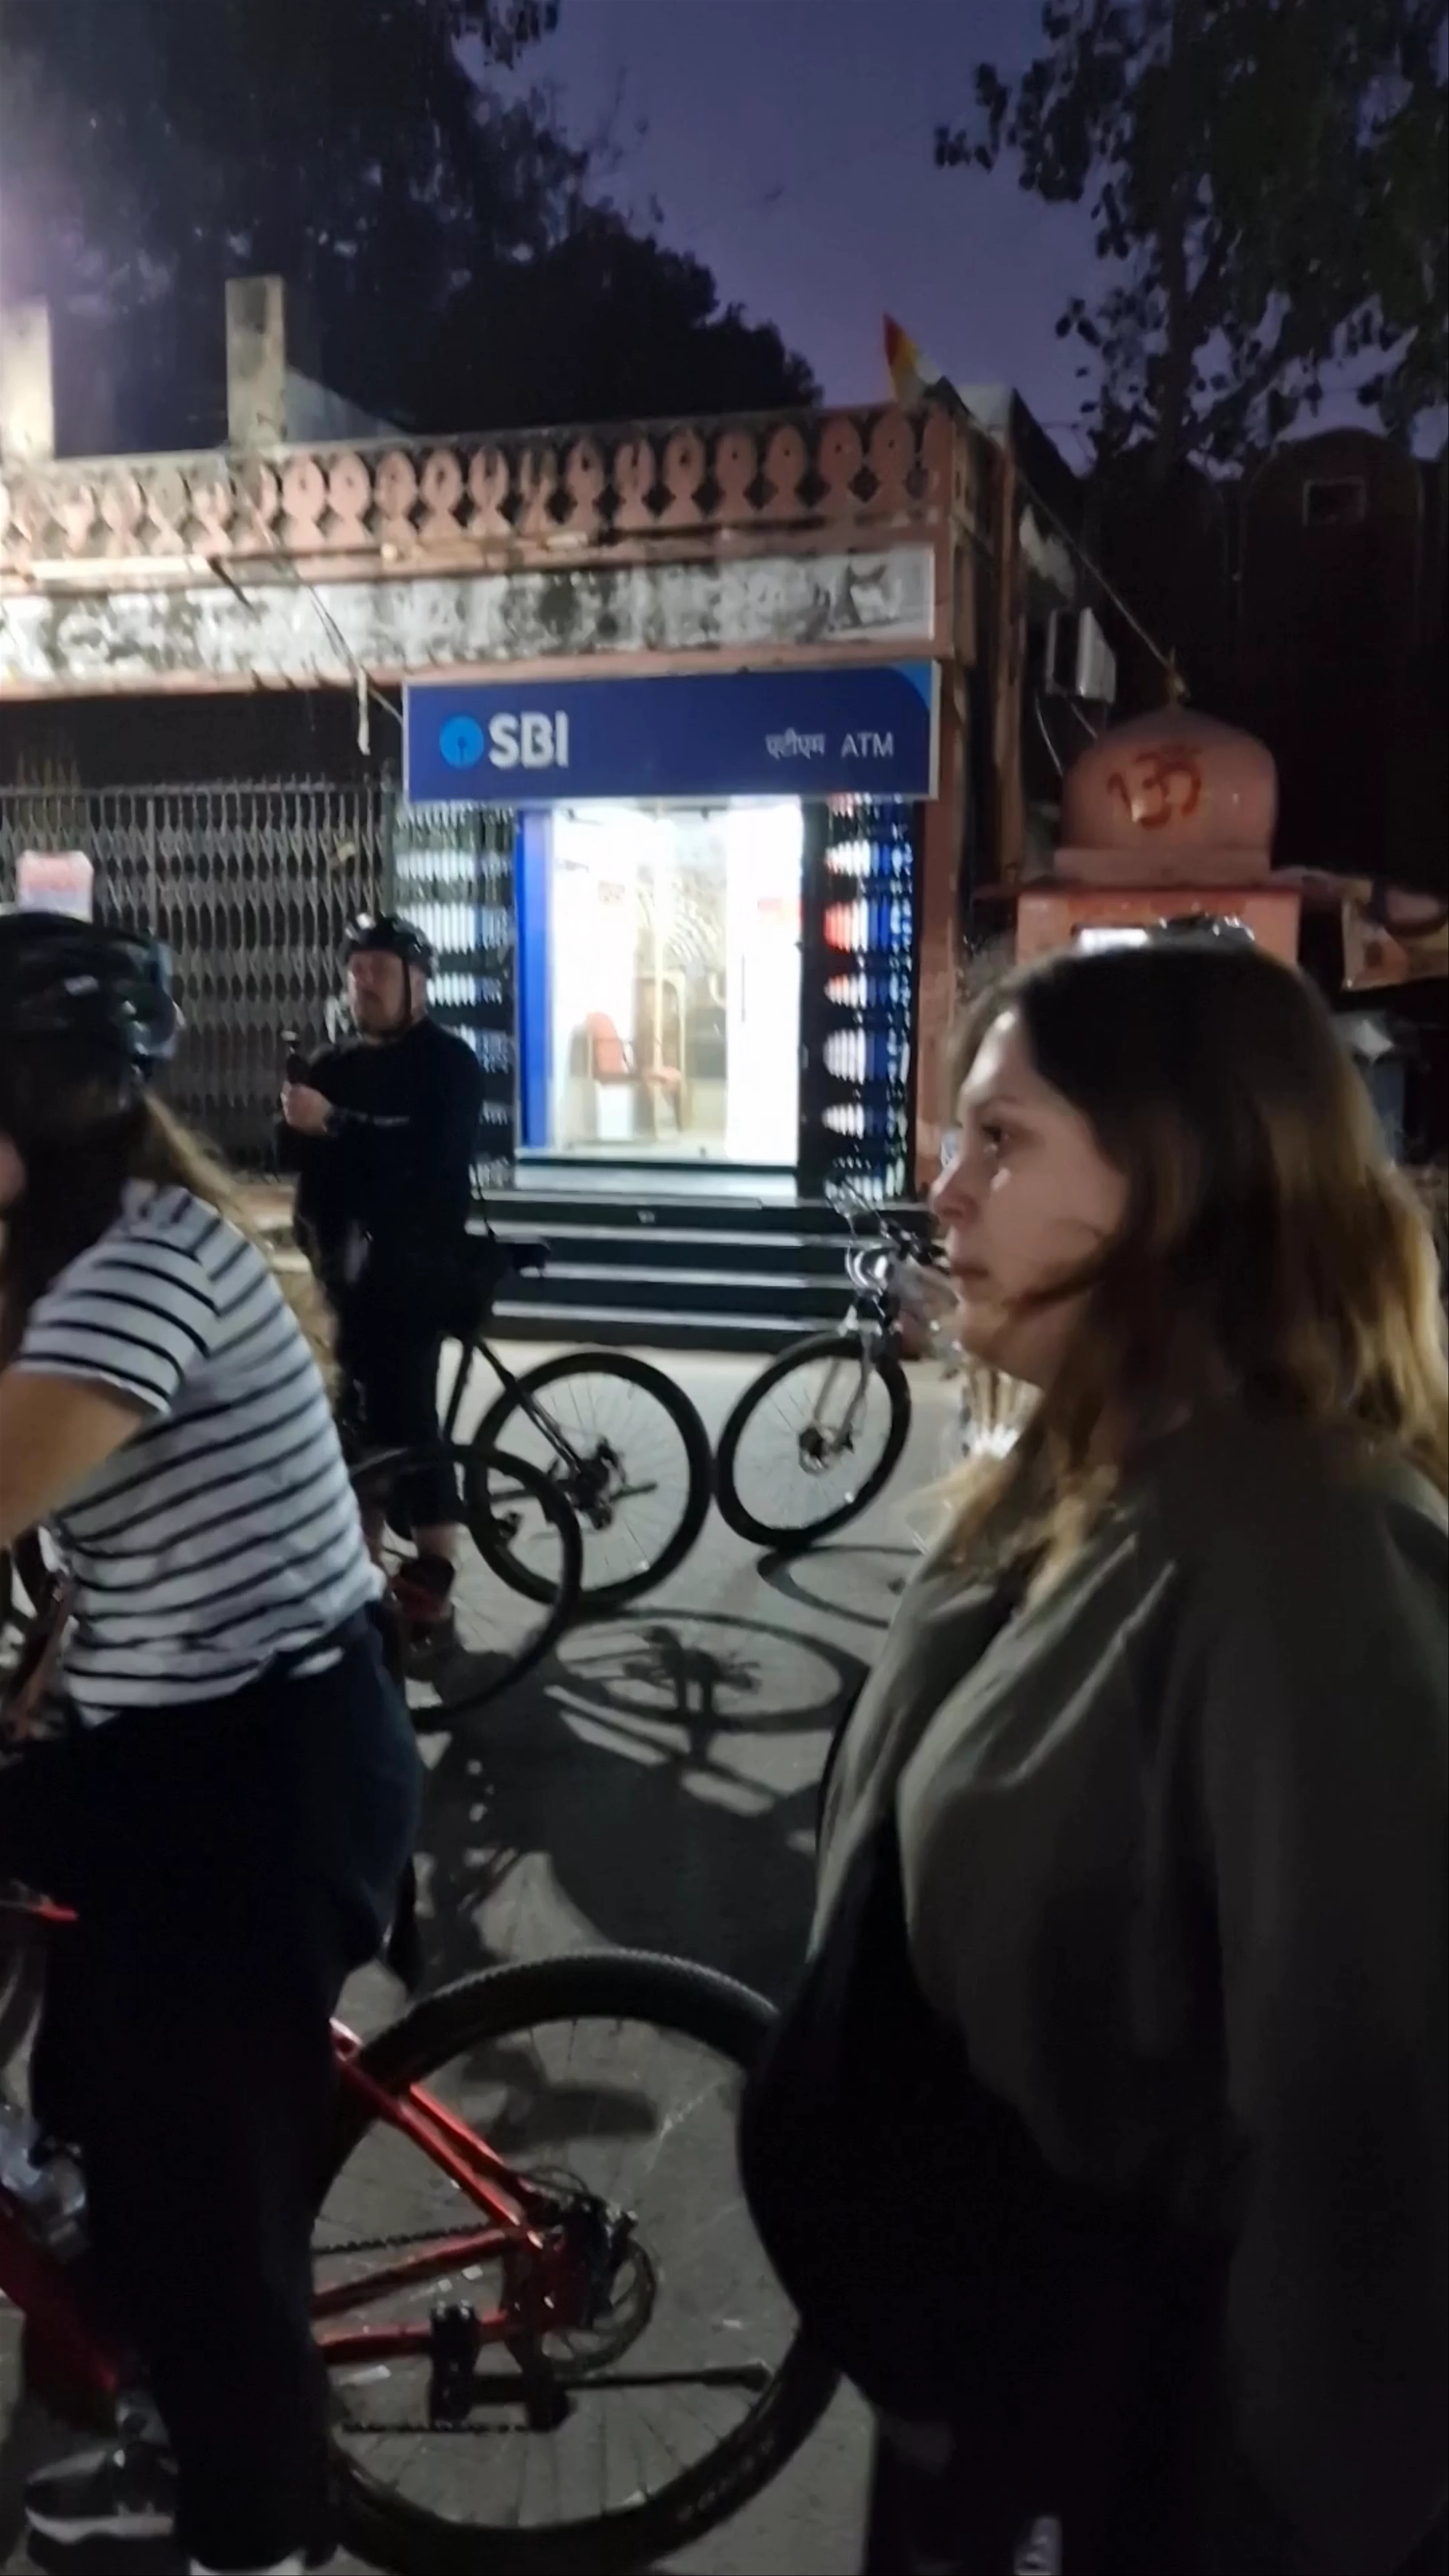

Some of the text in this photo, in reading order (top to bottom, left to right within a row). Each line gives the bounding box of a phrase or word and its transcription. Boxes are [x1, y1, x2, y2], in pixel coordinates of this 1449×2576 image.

[488, 710, 569, 769] SBI
[766, 727, 824, 759] एटीएम
[841, 732, 894, 757] ATM
